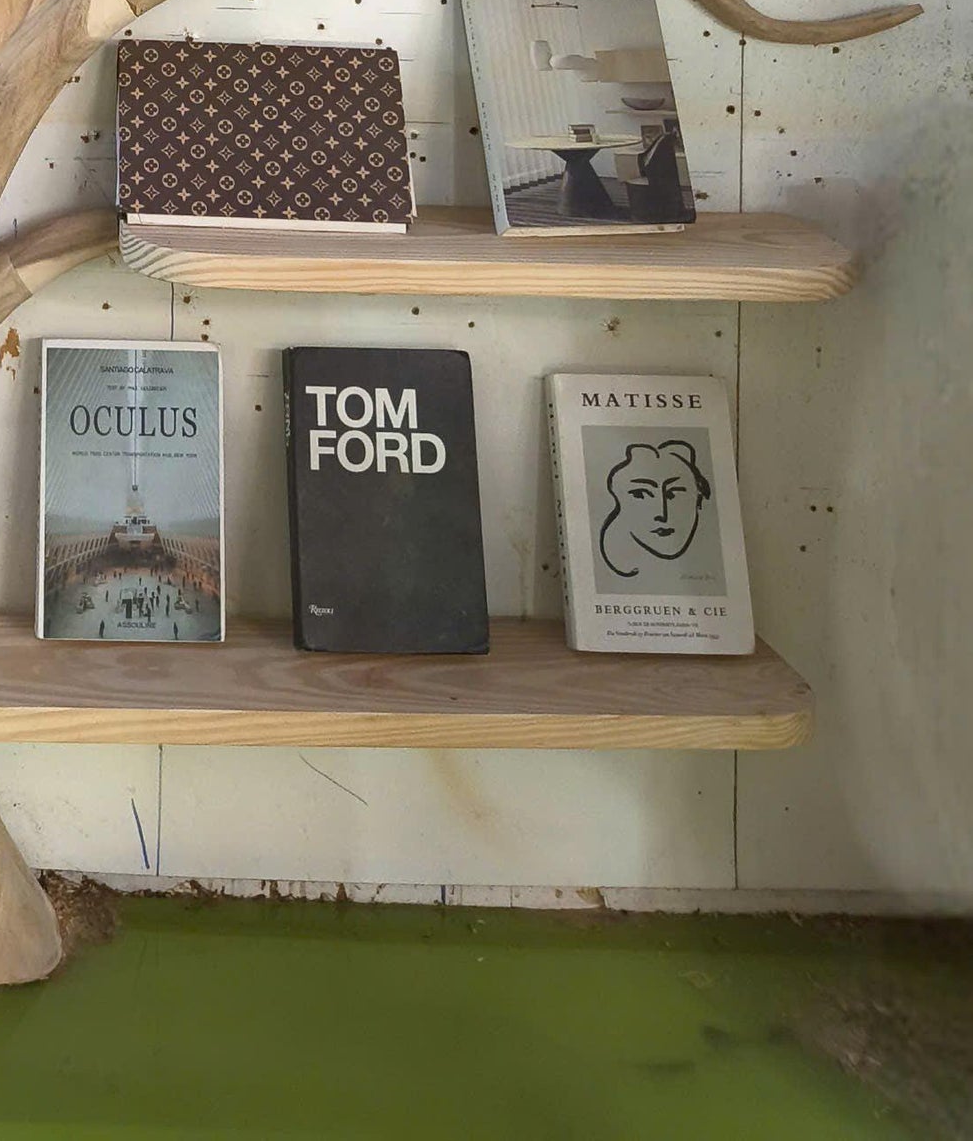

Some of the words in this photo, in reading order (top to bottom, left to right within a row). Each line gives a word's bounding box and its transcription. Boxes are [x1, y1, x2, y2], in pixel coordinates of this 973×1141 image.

[305, 386, 418, 429] TOM
[581, 393, 702, 409] MATISSE
[70, 405, 197, 438] OCULUS
[309, 429, 446, 474] FORD
[595, 605, 681, 616] BERGGRUEN
[688, 608, 697, 616] &
[703, 607, 728, 617] CIE
